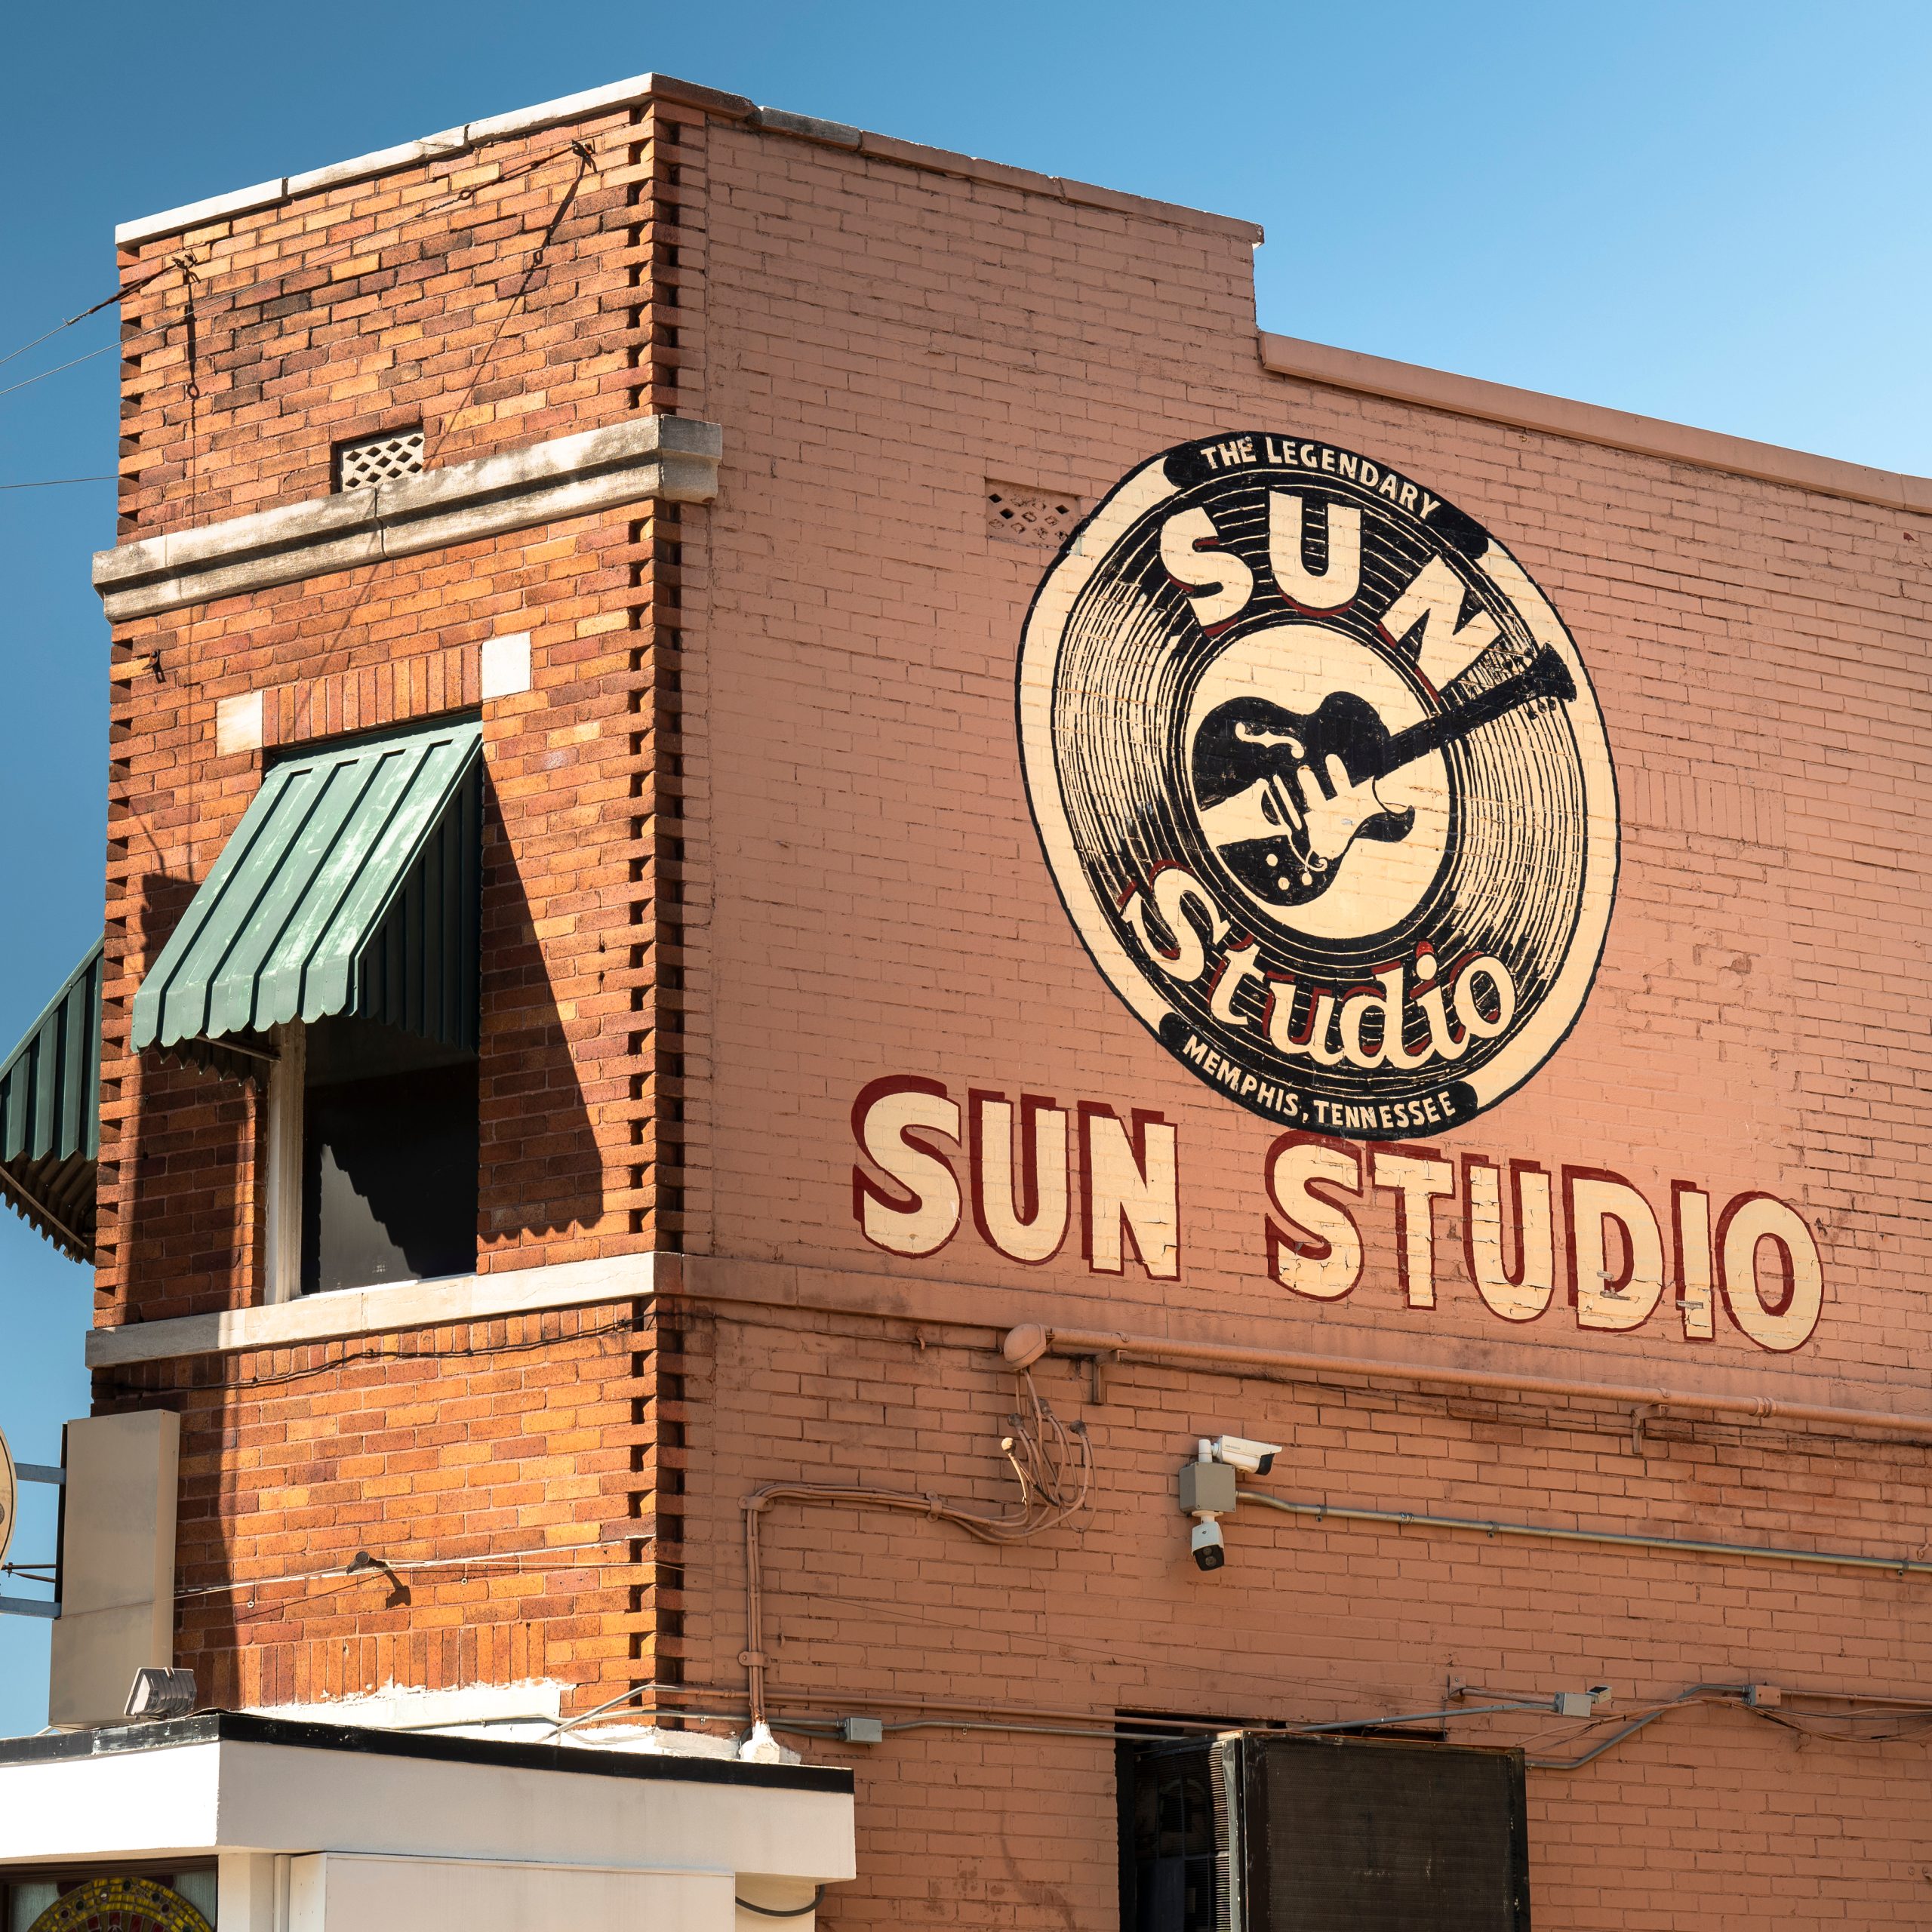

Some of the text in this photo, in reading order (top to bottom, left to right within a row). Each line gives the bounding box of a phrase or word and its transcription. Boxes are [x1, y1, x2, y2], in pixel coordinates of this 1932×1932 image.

[1201, 436, 1441, 520] THE LEGENDARY
[1158, 489, 1510, 703] SUN
[1117, 859, 1516, 1069] Studio
[1182, 1034, 1457, 1129] MEMPHIS, TENNESSEE
[851, 1074, 1824, 1352] SUN STUDIO
